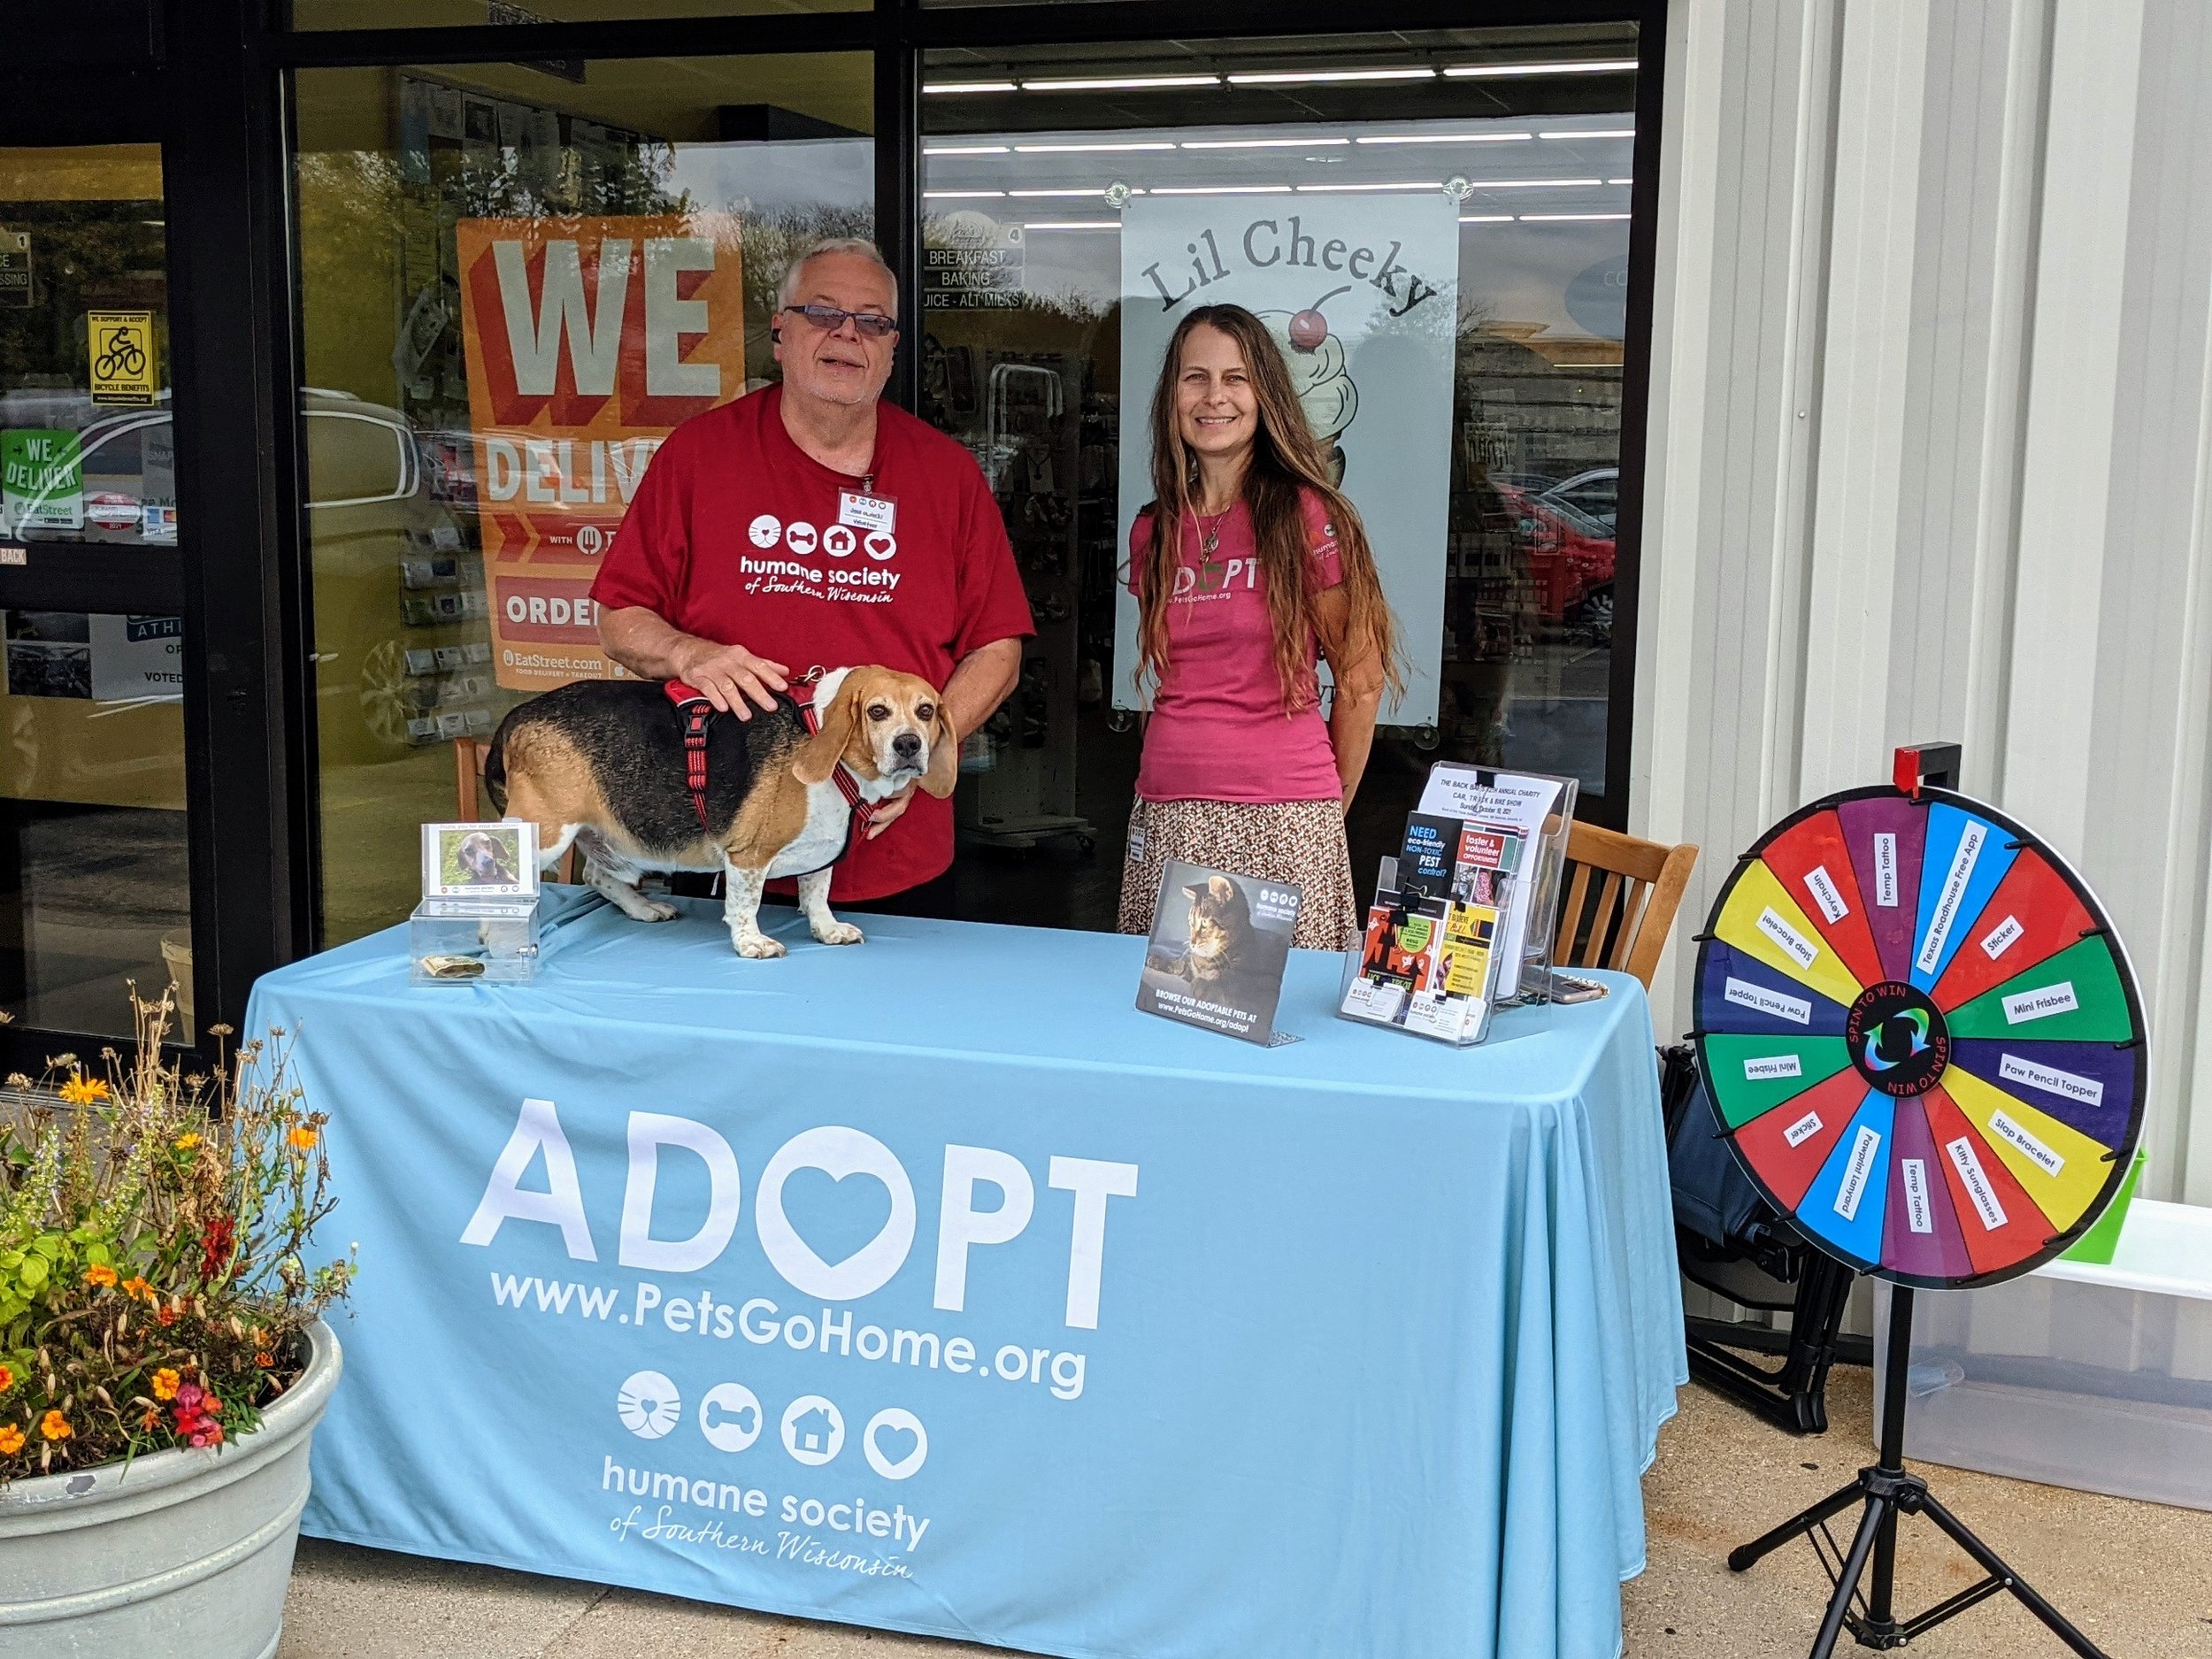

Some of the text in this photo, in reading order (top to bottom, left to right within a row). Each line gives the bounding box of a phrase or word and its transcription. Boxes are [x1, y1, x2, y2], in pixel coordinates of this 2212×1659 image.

[1010, 229, 1019, 242] 4
[930, 250, 1005, 265] BREAKFAST
[1141, 216, 1437, 317] Lil Cheeky
[941, 272, 990, 286] BAKING
[959, 294, 980, 306] ALT
[492, 239, 721, 396] WE
[26, 439, 53, 462] WE
[6, 462, 77, 491] DELIVER
[486, 439, 664, 503] DELIV
[1, 549, 26, 563] BACK
[741, 556, 901, 589] humane society
[745, 576, 894, 603] of Southern Wisconsin
[515, 653, 602, 671] EatStreet.com
[144, 672, 183, 683] VOTED
[1453, 780, 1468, 789] BACK
[1518, 789, 1540, 798] CHARITY
[1407, 838, 1445, 850] eco-friendly
[1409, 826, 1437, 840] NEED
[1466, 835, 1488, 846] foster
[1406, 845, 1442, 856] NON-TOXIC
[1419, 855, 1440, 867] PEST
[1465, 844, 1500, 856] volunteer
[1417, 867, 1447, 877] control?
[1814, 874, 1841, 919] Keychain
[1883, 872, 1893, 902] Temp
[1923, 833, 1978, 964] Texas Roadhouse Free App
[1762, 914, 1813, 962] Slap Bracelet
[1987, 923, 2016, 952] Sticker
[1156, 989, 1257, 1023] BROWSE OUR ADOPTABLE PETS AT
[1729, 988, 1807, 1019] Paw Pencil Topper
[1849, 985, 1906, 1043] SPIN TO WIN
[2014, 993, 2071, 1015] Mini Frisbee
[1748, 1062, 1797, 1073] Mini Frisbee
[1887, 1036, 1947, 1094] SPIN TO WIN
[2004, 1063, 2097, 1099] Paw Pencil Topper
[1791, 1118, 1817, 1140] Sticker
[1995, 1118, 2056, 1169] Slap Bracelet
[1842, 1133, 1873, 1214] Pawprint Lanyard
[1955, 1144, 1998, 1223] Kitty Sunglasses
[1909, 1164, 1924, 1227] Temp Tattoo
[459, 1098, 1139, 1330] ADOPT
[490, 1271, 1087, 1401] www.PetsGoHome.org
[602, 1455, 931, 1553] humane society
[611, 1505, 914, 1579] of Southern Wisconsin
